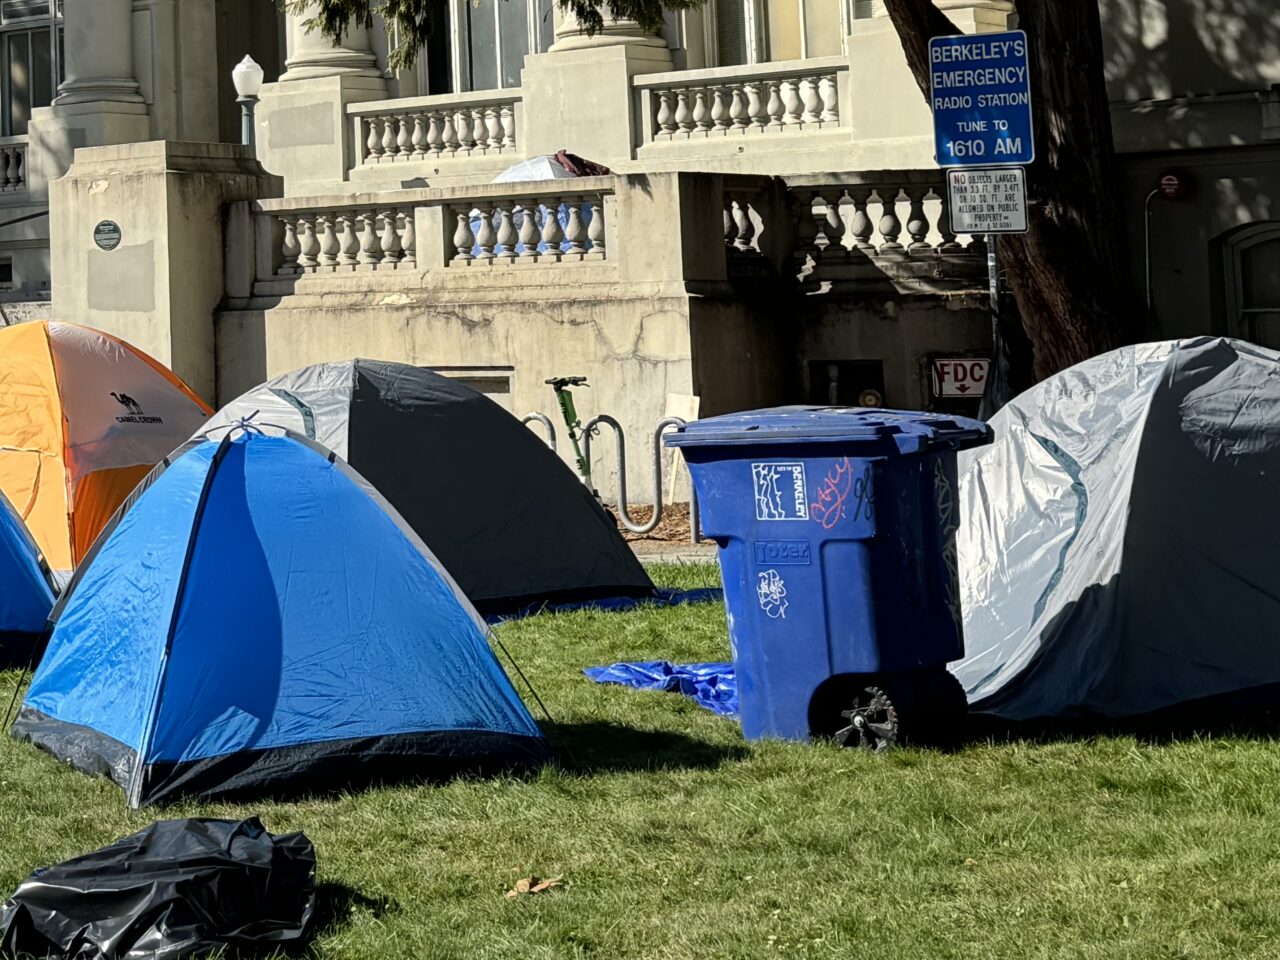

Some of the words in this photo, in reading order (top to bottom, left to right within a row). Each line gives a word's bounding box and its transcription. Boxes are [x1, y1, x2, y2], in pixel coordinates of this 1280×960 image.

[932, 40, 1025, 63] BERKELEY'S
[933, 66, 1026, 89] EMERGENCY
[935, 95, 972, 110] RADIO
[977, 92, 1028, 108] STATION
[956, 120, 988, 133] TUNE
[993, 119, 1008, 131] TO
[946, 140, 984, 157] 1610
[994, 138, 1022, 155] AM
[954, 174, 966, 184] NO
[968, 175, 993, 184] OBJECTS
[995, 174, 1017, 183] LARGER
[953, 185, 967, 194] THAN
[993, 184, 1001, 193] BY
[959, 195, 967, 203] OR
[1004, 193, 1016, 202] ARE
[958, 204, 984, 213] ALLOWED
[986, 204, 995, 212] ON
[998, 203, 1019, 212] PUBLIC
[939, 362, 984, 383] FDC
[792, 466, 806, 518] BERKELEY
